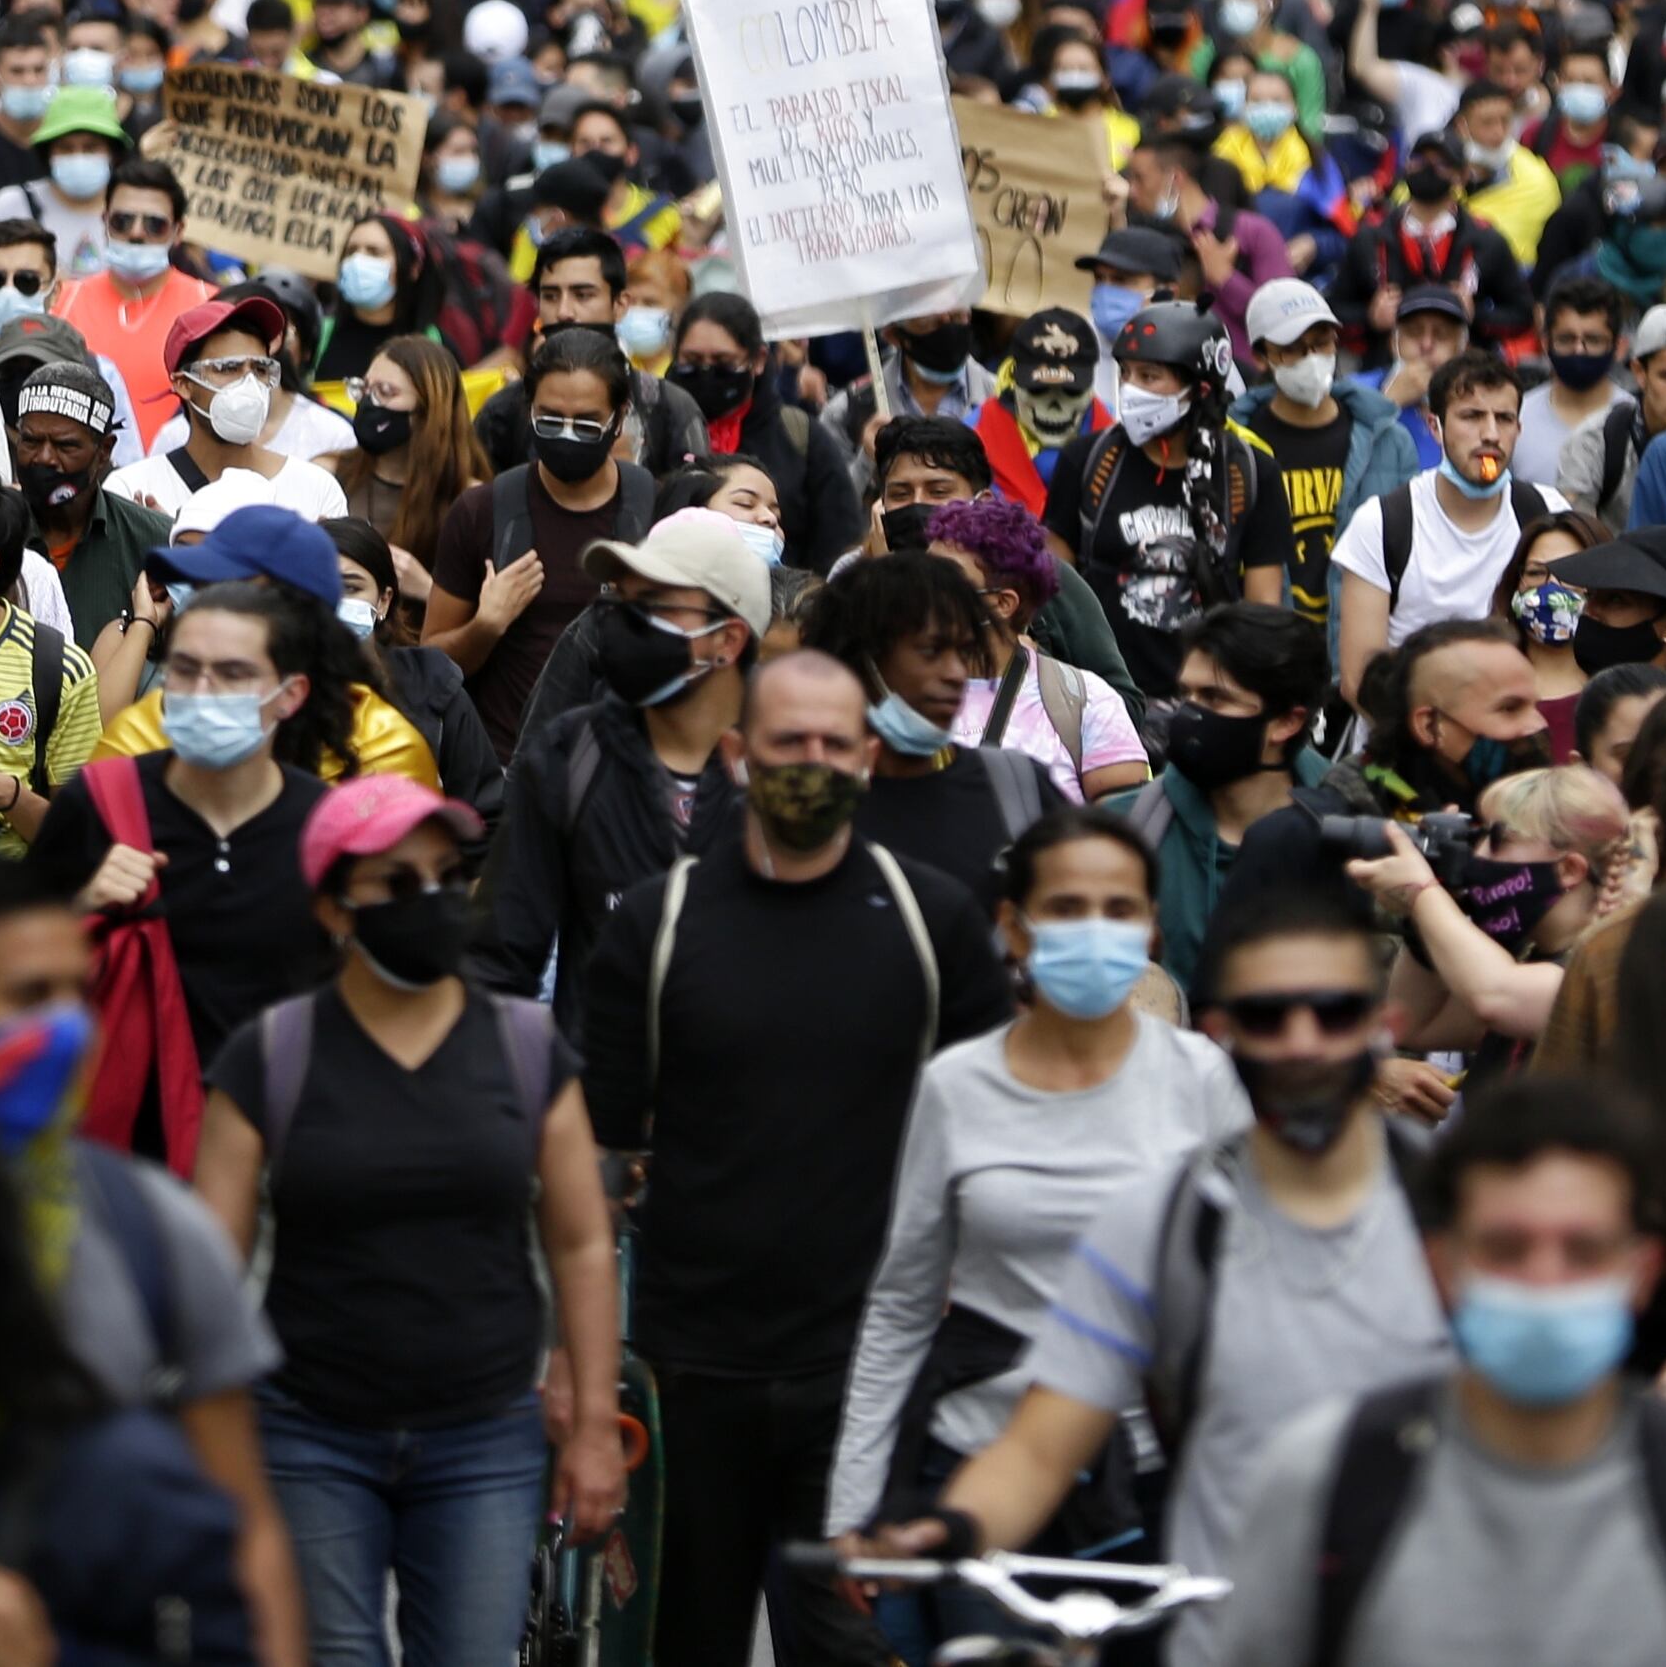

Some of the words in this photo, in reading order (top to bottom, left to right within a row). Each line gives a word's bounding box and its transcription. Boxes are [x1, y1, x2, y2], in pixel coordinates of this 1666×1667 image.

[295, 83, 342, 118] SON
[361, 93, 405, 134] LOS
[730, 103, 762, 134] EL
[767, 85, 844, 125] PARAISO
[847, 73, 911, 110] FISCAL
[225, 104, 353, 158] PROVOCAN
[366, 135, 397, 170] LA
[779, 126, 808, 154] DE
[813, 113, 860, 145] RICOS
[862, 108, 875, 136] Y
[242, 176, 277, 205] QUE
[818, 163, 864, 205] PERO
[747, 216, 767, 247] EL
[768, 200, 856, 242] INFIERNO
[861, 188, 906, 223] PARA
[909, 181, 941, 213] LOS
[284, 218, 334, 255] ELLA
[29, 395, 89, 424] TRIBUTARIA
[50, 385, 91, 409] REFORMA
